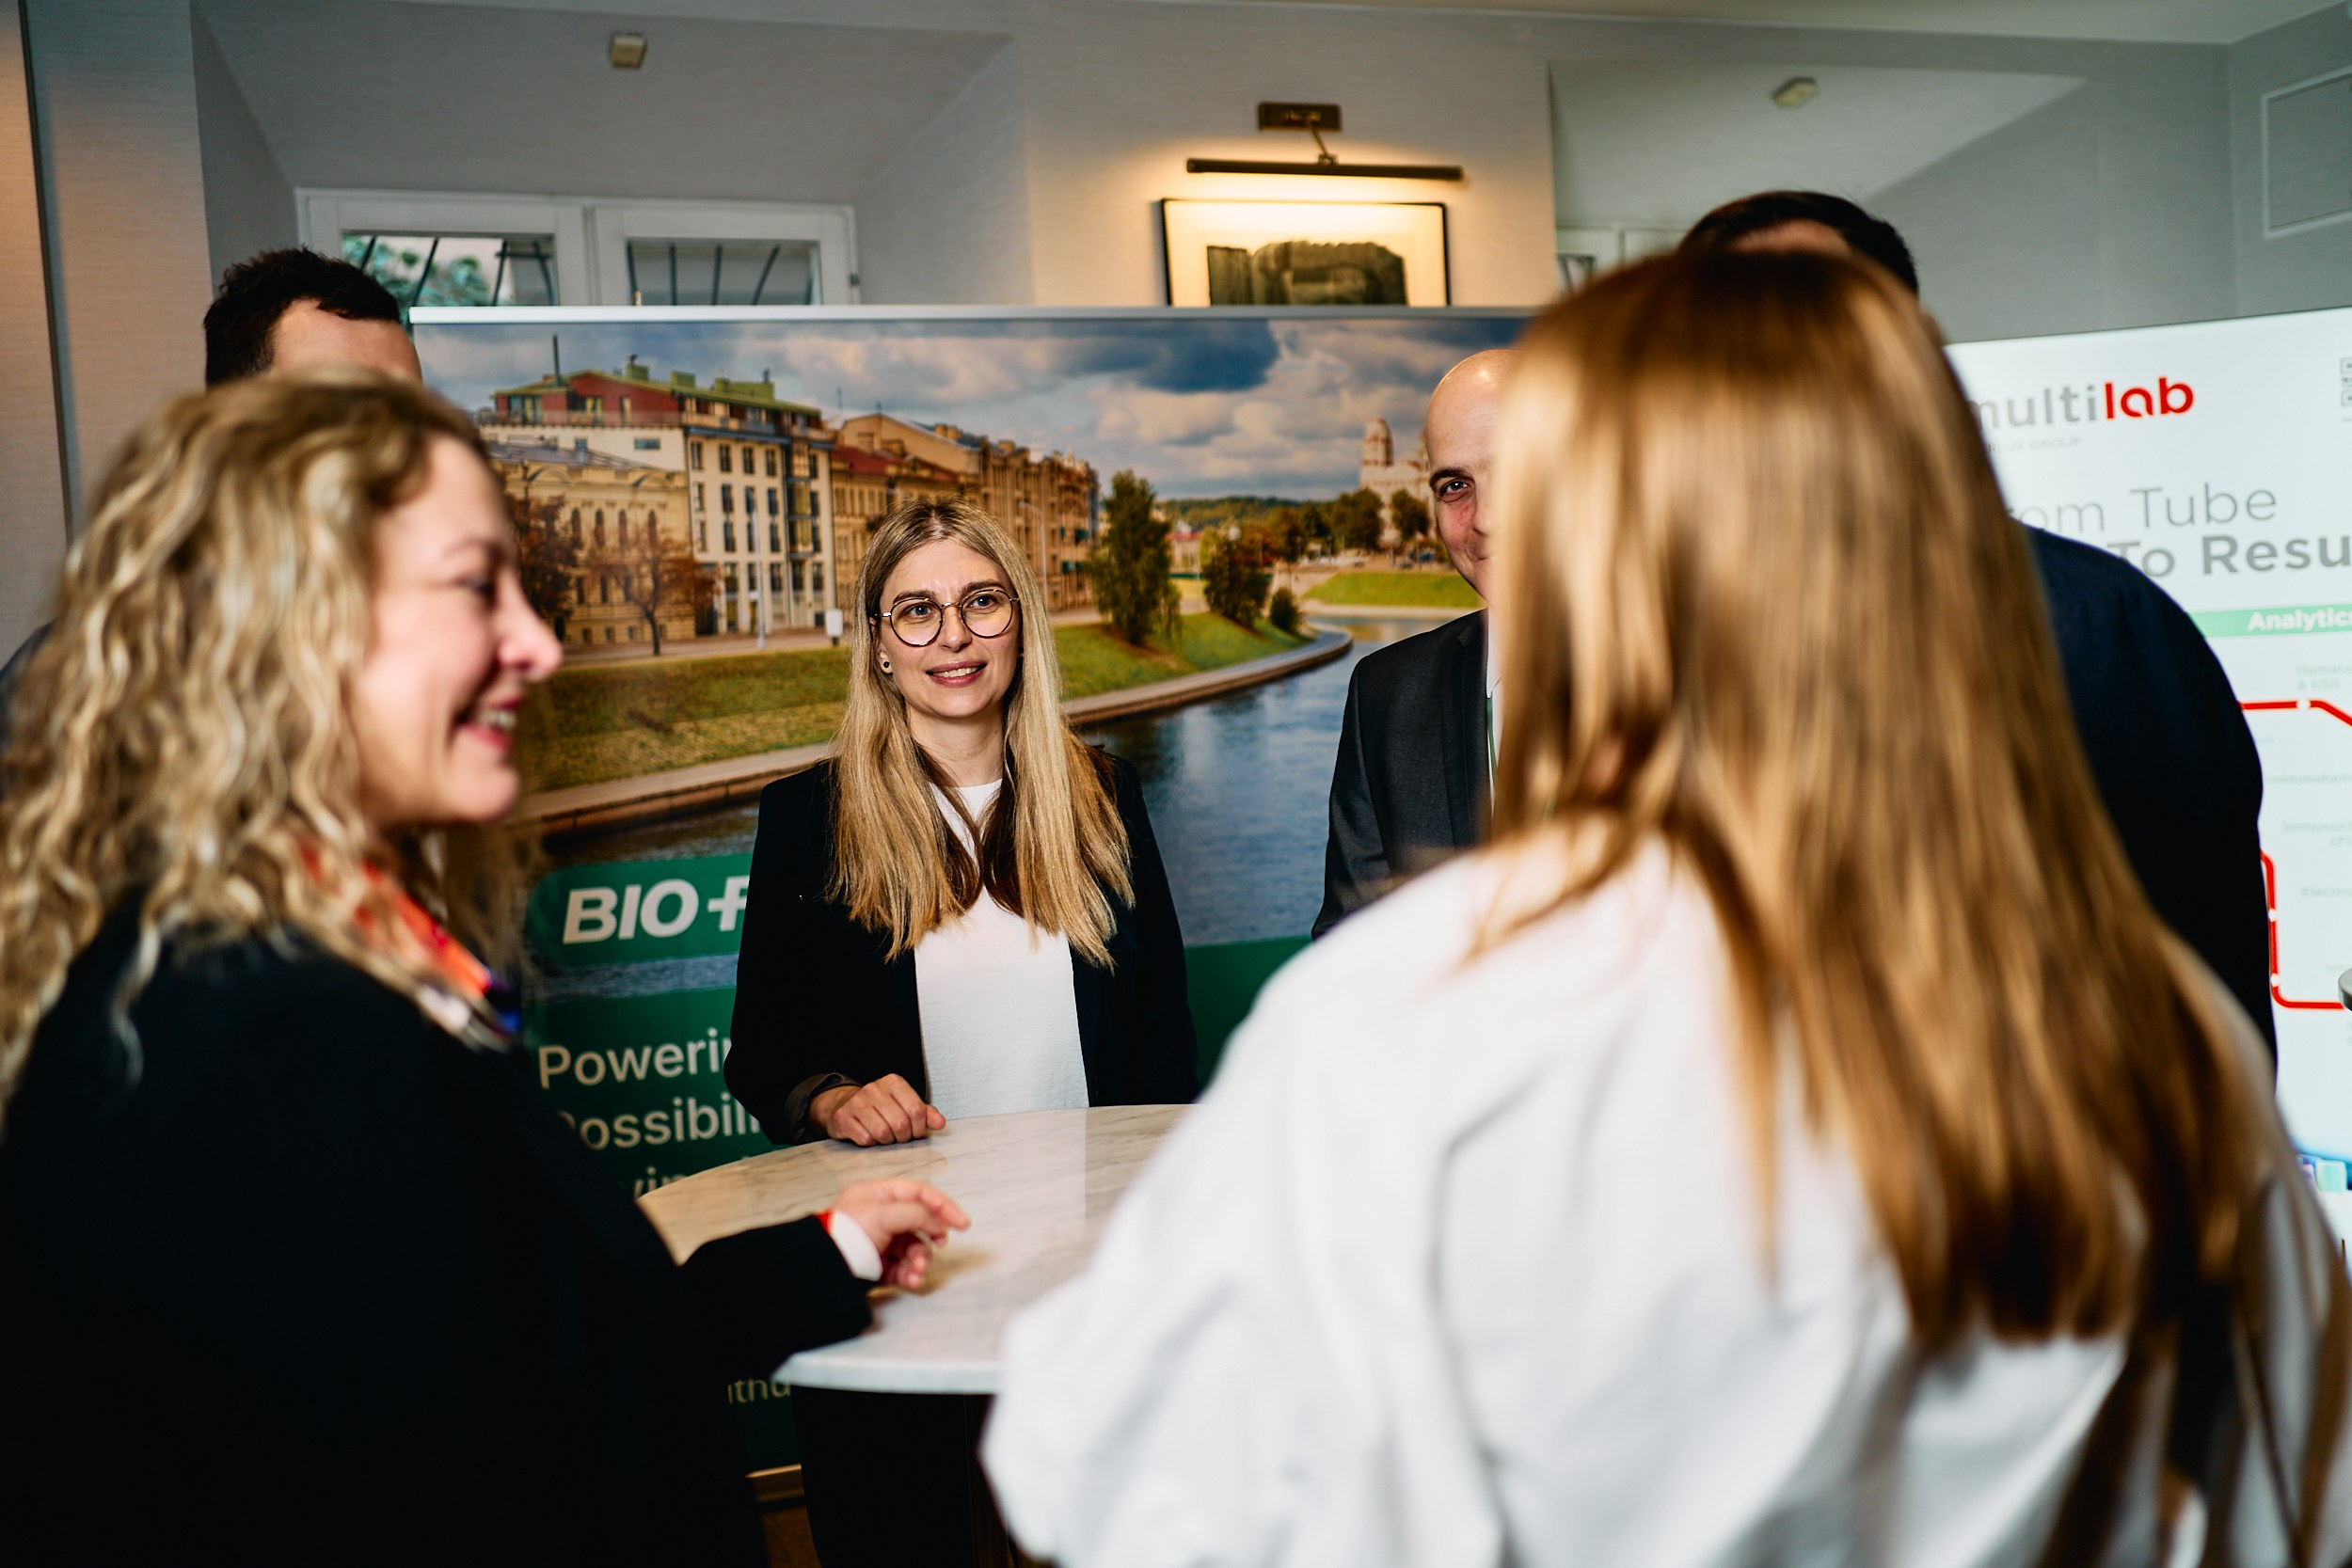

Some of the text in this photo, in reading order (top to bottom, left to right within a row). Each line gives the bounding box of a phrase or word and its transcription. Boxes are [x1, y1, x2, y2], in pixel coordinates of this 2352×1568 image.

[2007, 482, 2277, 532] om Tube
[2201, 533, 2351, 576] Resu
[557, 1092, 760, 1150] ossibil
